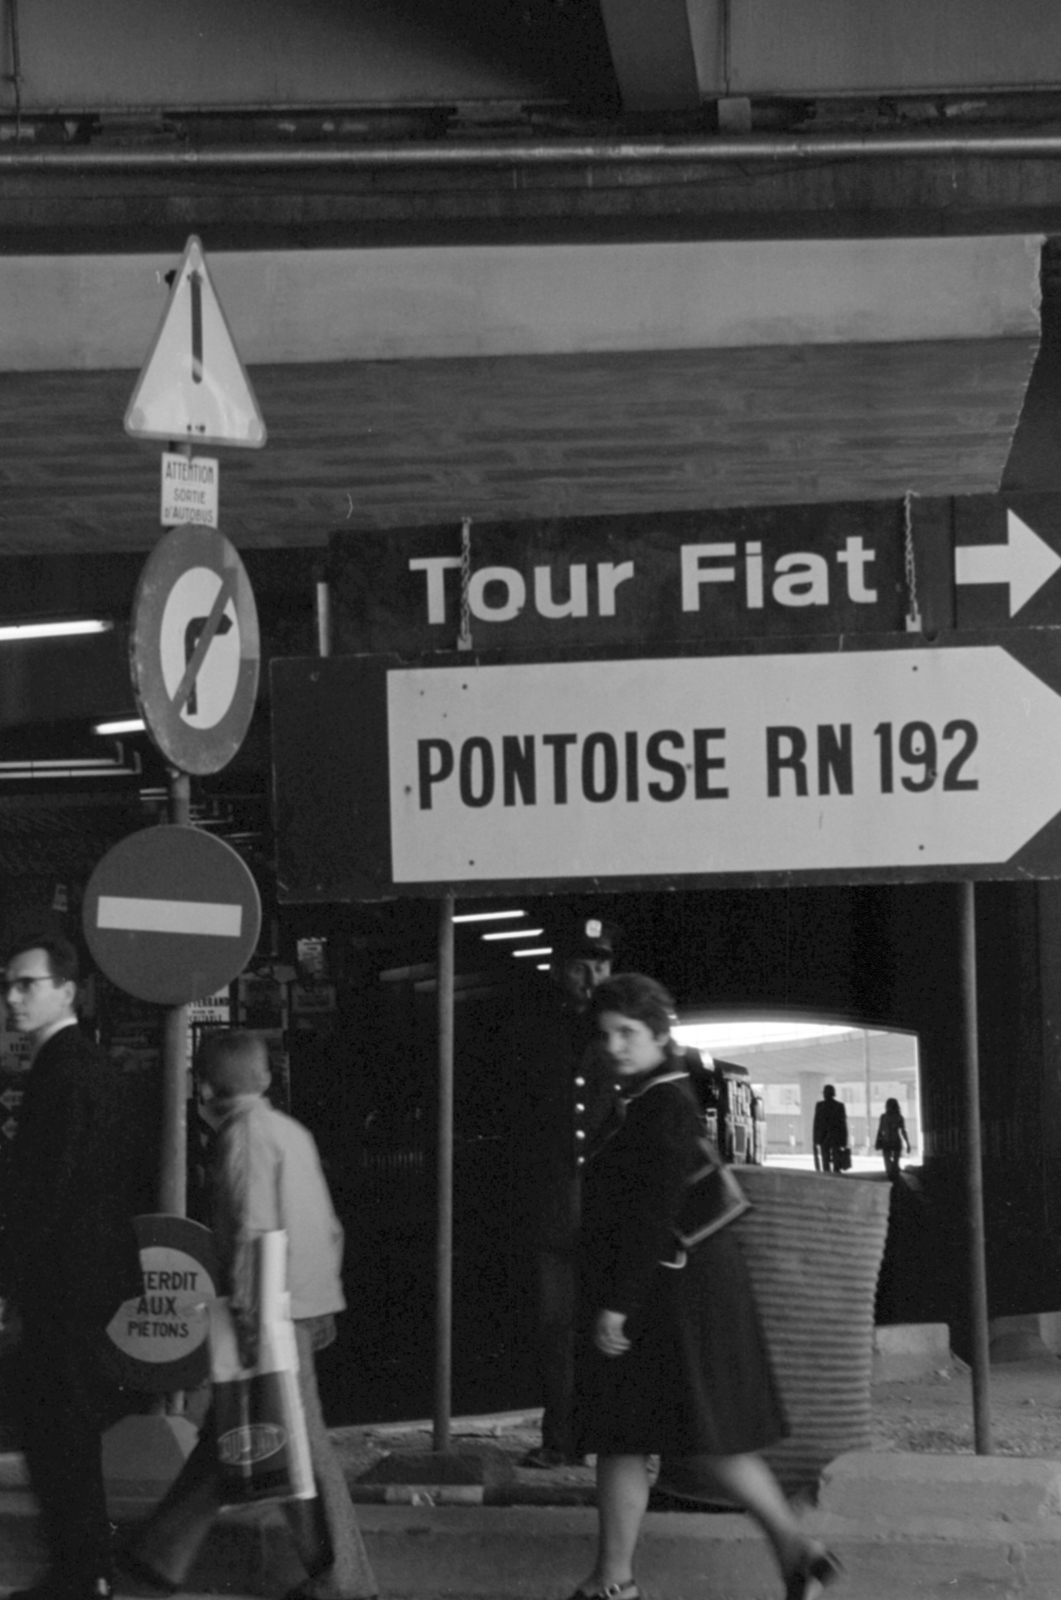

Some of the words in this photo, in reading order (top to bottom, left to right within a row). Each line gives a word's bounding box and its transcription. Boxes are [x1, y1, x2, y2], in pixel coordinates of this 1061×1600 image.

[165, 461, 214, 484] ATTENTION
[174, 488, 206, 504] SORTIE
[164, 506, 214, 523] D'AUTOBUS
[409, 557, 634, 624] Tour
[681, 536, 877, 612] Fiat
[417, 729, 729, 810] PONTOISE
[766, 724, 854, 797] RN
[874, 719, 979, 794] 192
[144, 1271, 198, 1290] ERDIT
[137, 1296, 177, 1316] AUX
